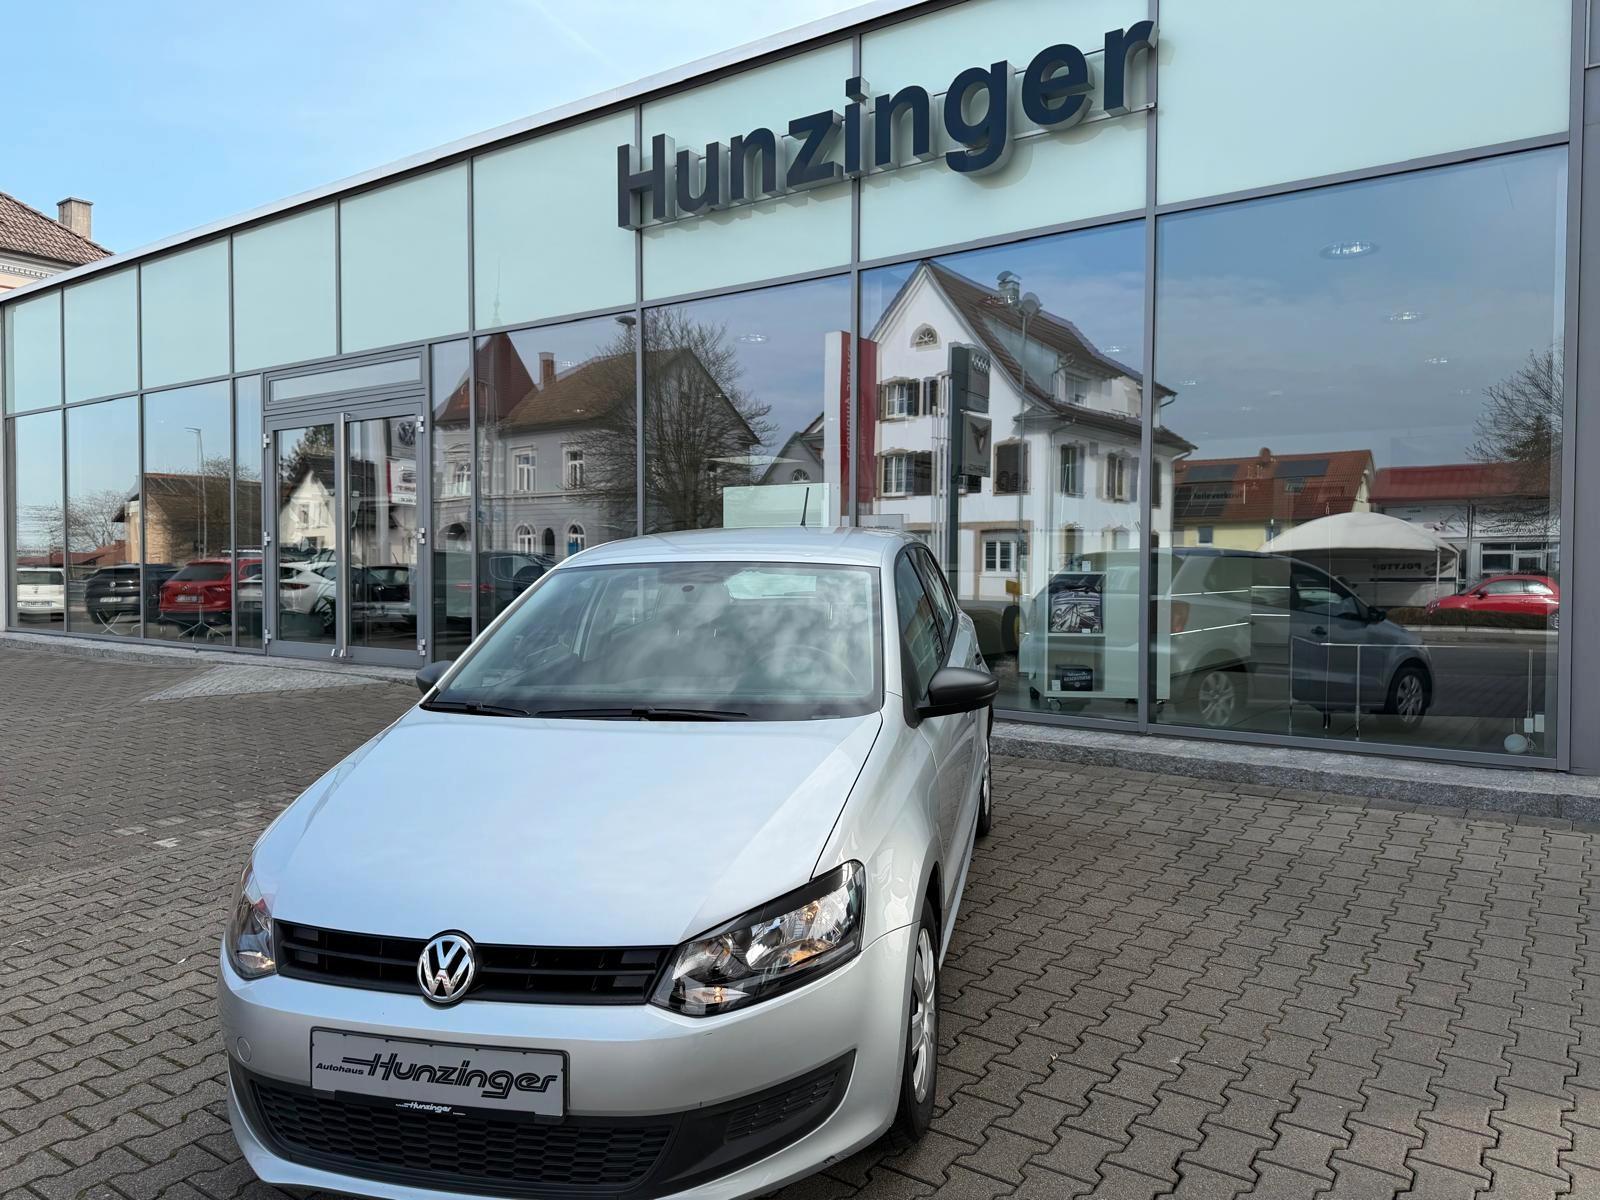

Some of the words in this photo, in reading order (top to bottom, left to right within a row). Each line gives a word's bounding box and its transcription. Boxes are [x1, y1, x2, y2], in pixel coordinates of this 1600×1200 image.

[617, 20, 1158, 230] Hunzinger
[315, 1062, 364, 1075] Autohaus
[341, 1053, 558, 1099] Hunzinger
[404, 1102, 452, 1113] Hunzinger
